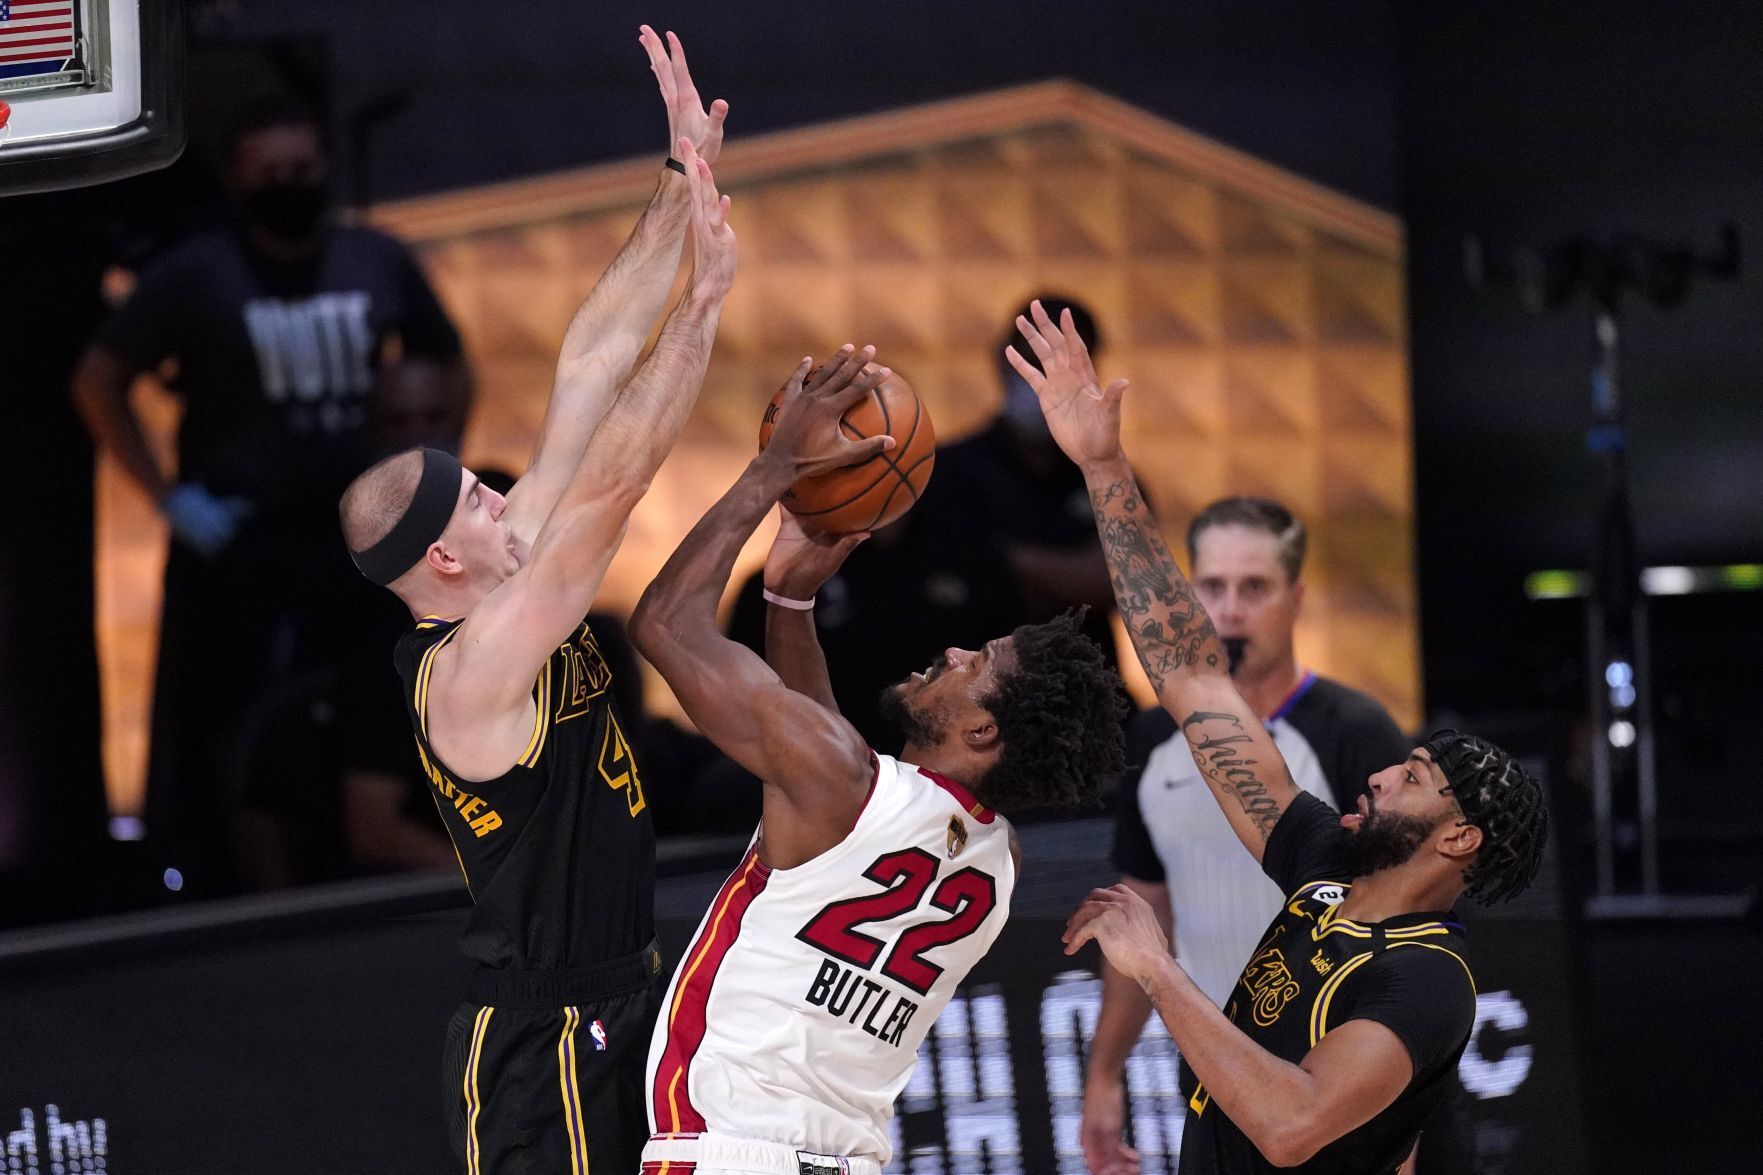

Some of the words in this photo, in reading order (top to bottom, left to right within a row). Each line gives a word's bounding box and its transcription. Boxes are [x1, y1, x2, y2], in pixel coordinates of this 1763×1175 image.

[414, 732, 503, 838] ATTER
[598, 703, 646, 818] 4
[794, 846, 996, 998] 22
[805, 958, 919, 1048] BUTLER
